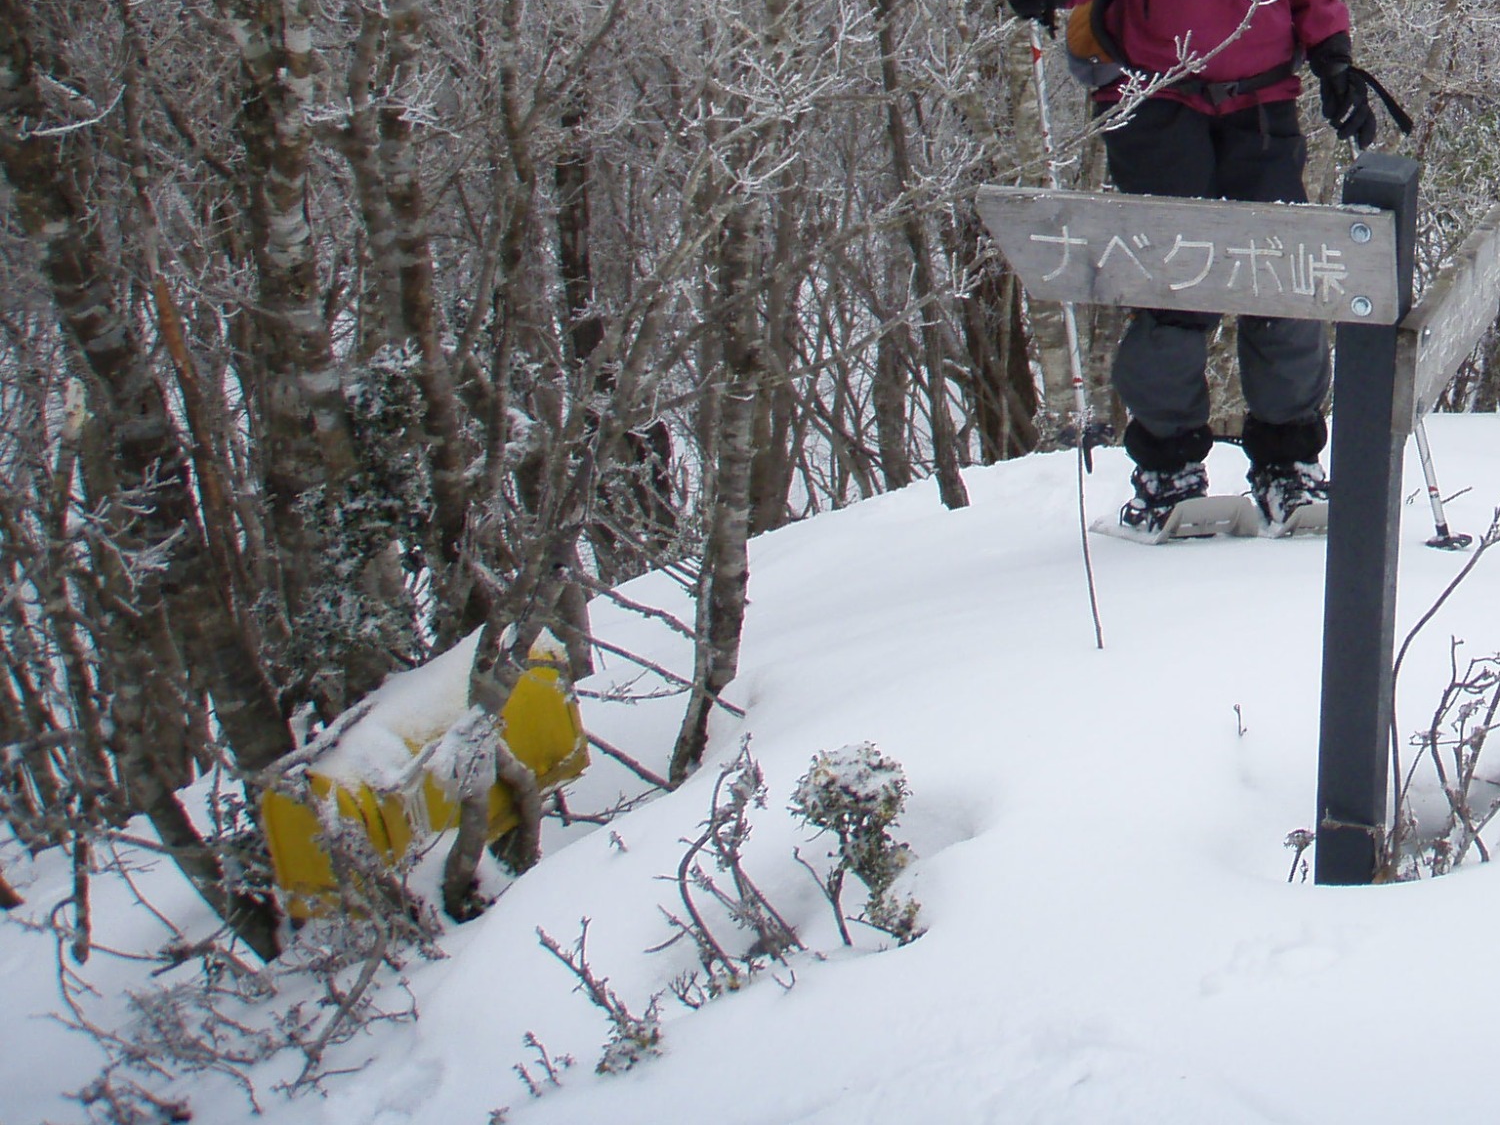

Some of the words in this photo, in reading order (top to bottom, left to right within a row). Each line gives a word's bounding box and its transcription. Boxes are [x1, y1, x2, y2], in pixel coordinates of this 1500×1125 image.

[1030, 225, 1349, 302] ナベクボ峠
